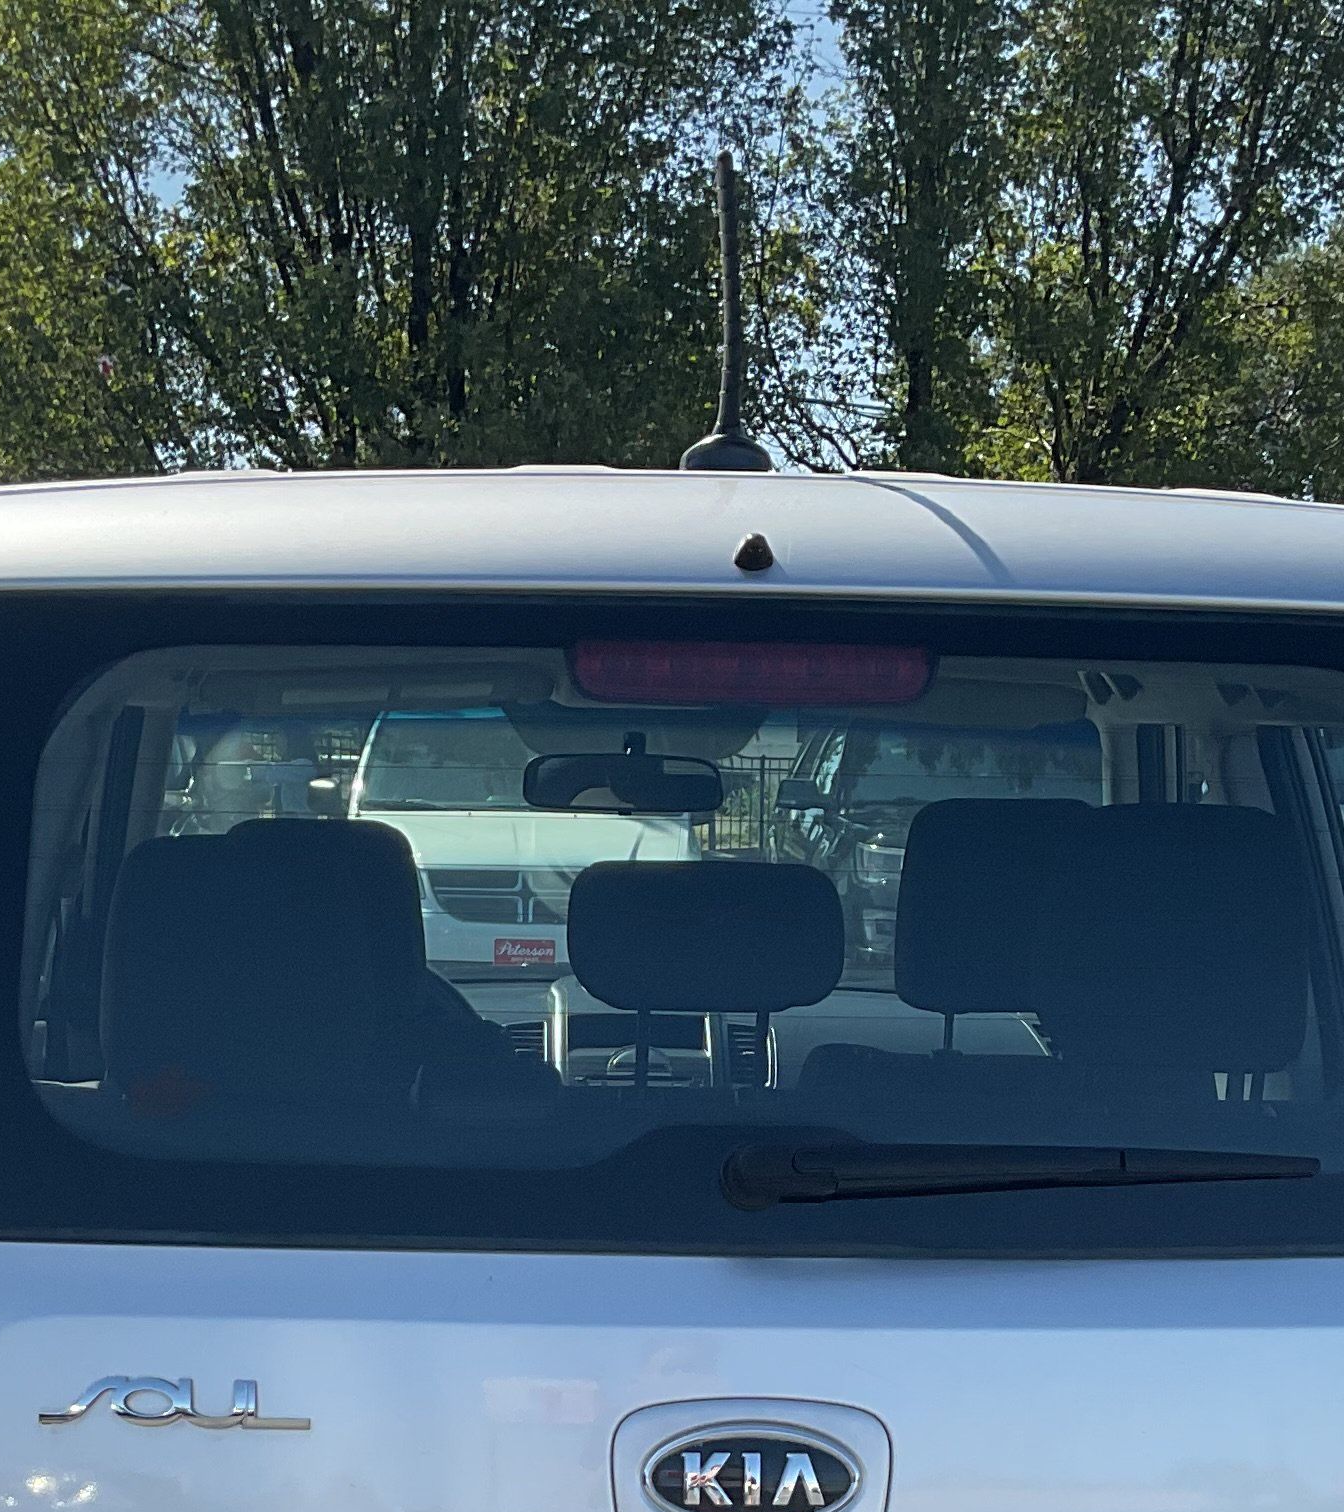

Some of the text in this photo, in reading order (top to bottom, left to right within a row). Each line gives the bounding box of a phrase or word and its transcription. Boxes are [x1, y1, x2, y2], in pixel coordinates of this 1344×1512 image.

[496, 940, 554, 956] Peterson
[38, 1375, 311, 1430] SOUL
[681, 1452, 825, 1506] KIA
